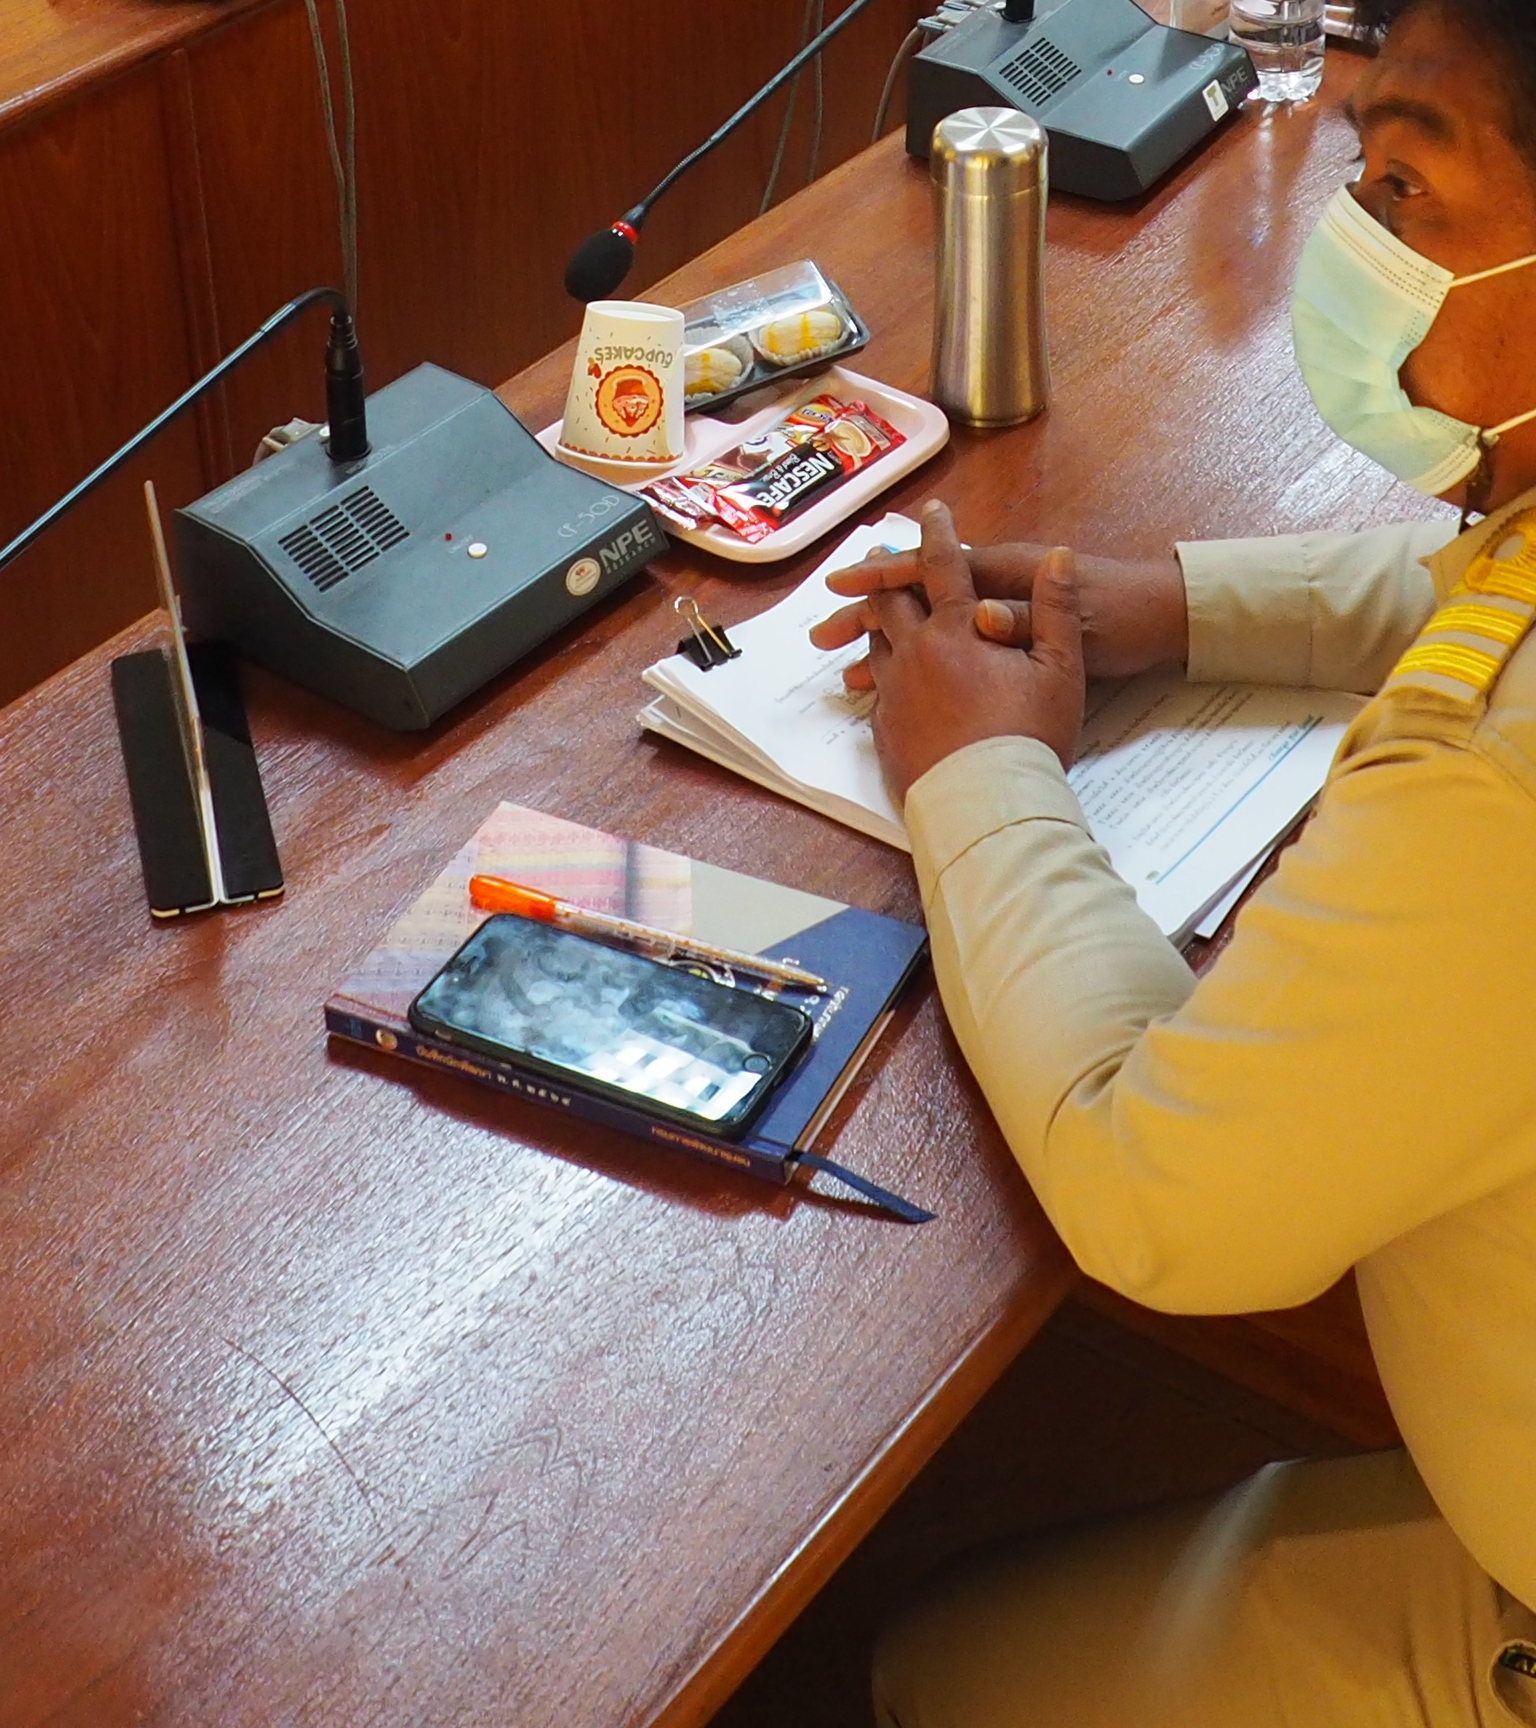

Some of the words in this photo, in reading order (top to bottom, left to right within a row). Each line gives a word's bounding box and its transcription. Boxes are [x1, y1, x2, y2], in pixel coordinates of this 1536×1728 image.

[1221, 67, 1248, 93] NPE
[594, 346, 673, 368] CUPCAKES
[599, 519, 653, 567] NPE
